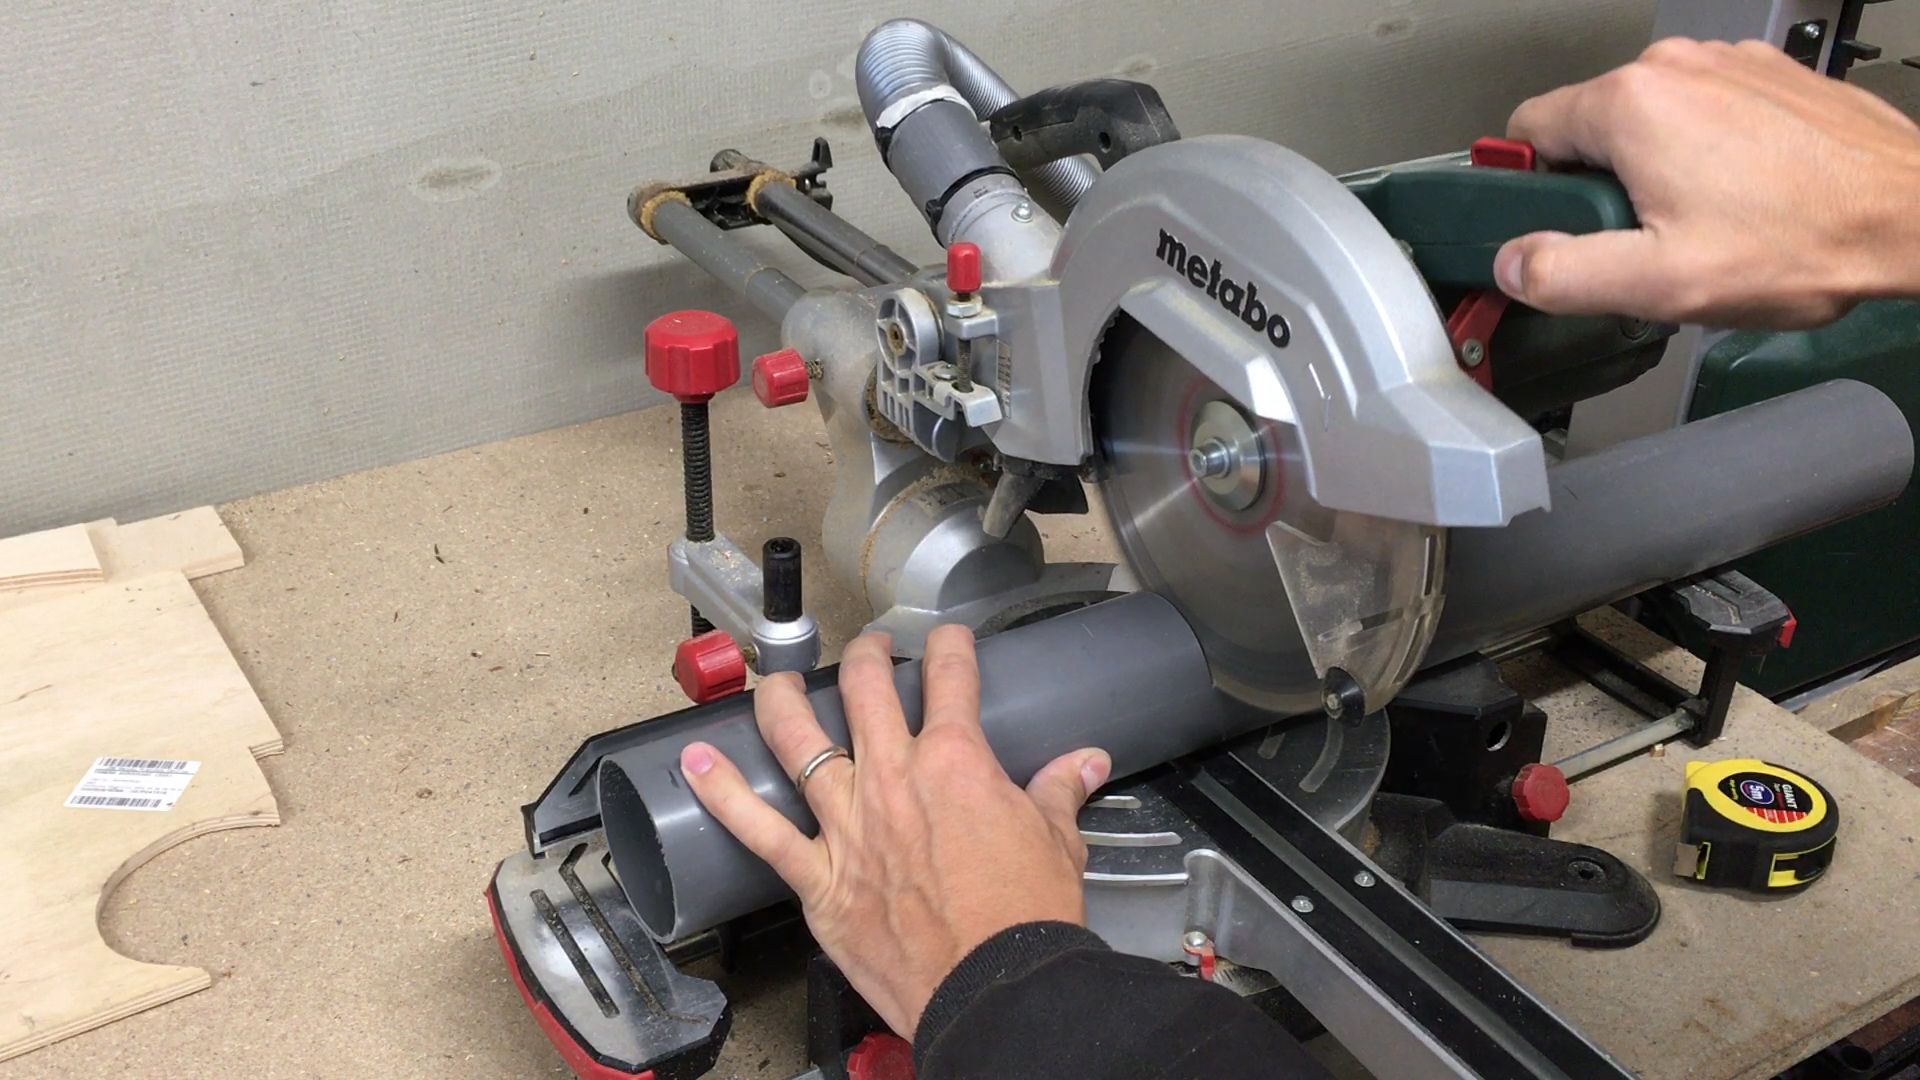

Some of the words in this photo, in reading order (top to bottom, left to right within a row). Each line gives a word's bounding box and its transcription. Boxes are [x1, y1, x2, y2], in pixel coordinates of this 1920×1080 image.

[1156, 228, 1291, 349] metabo
[1750, 785, 1765, 799] 5m
[1782, 784, 1798, 809] GIANT
